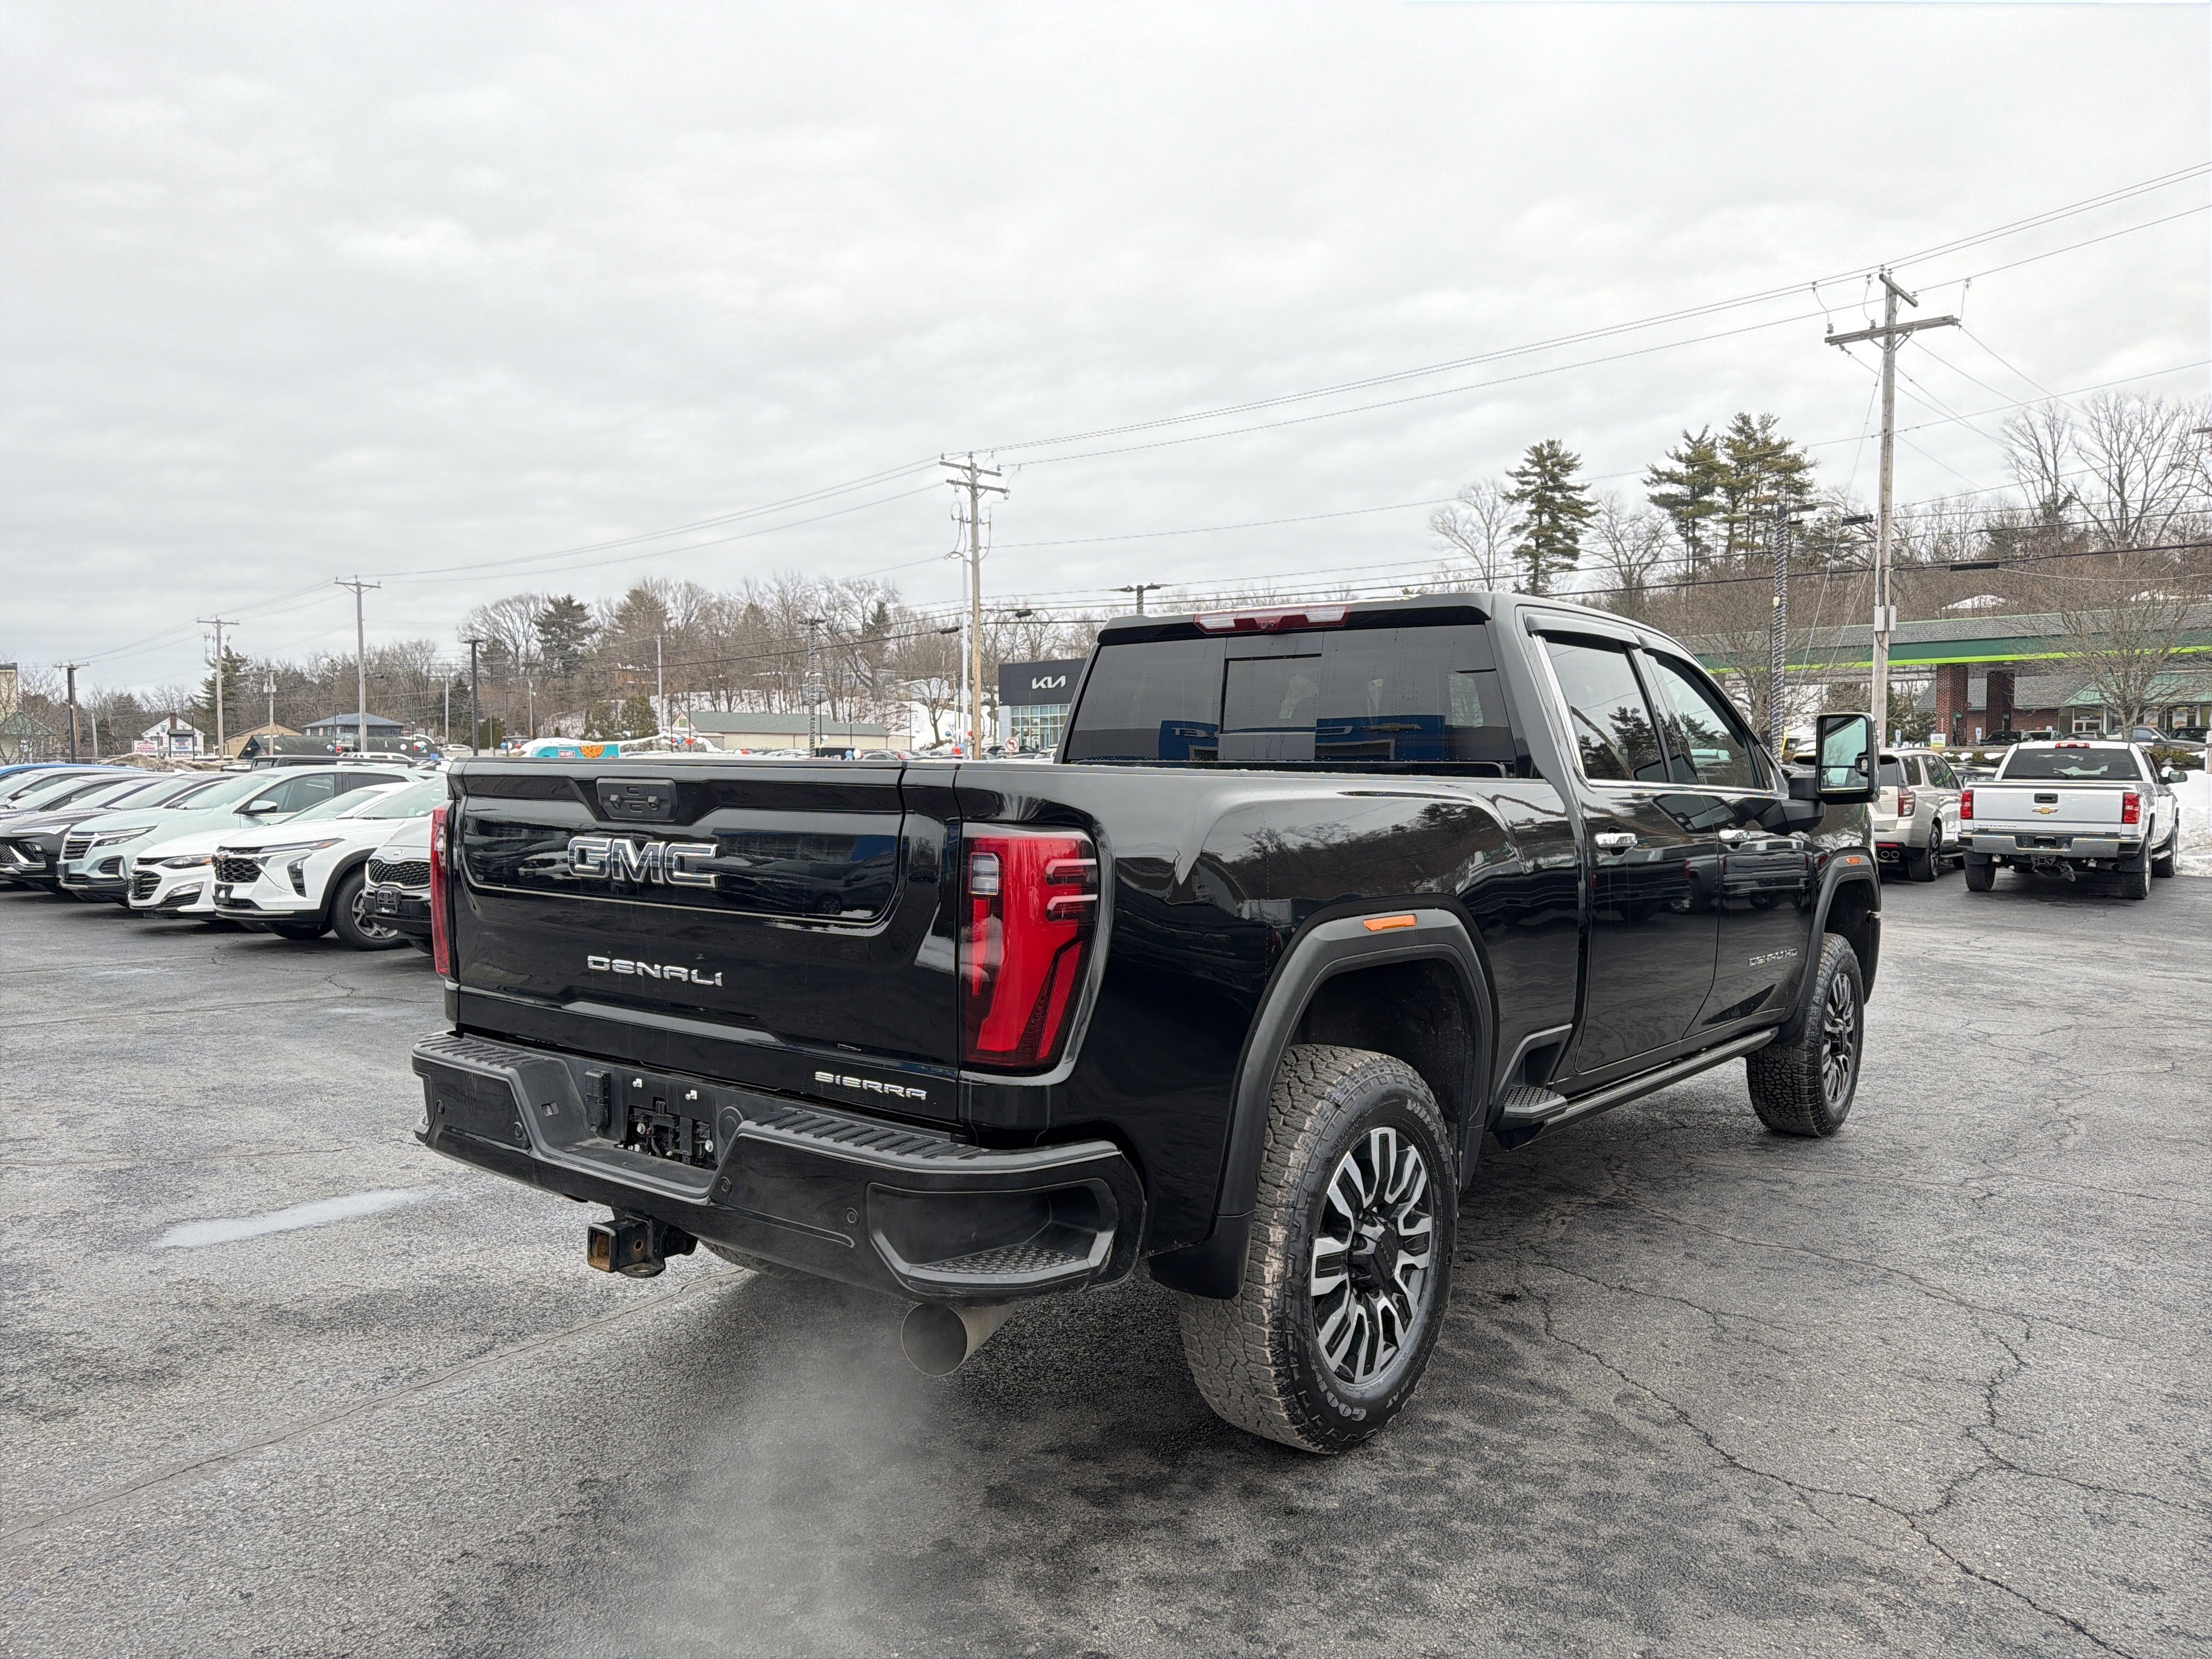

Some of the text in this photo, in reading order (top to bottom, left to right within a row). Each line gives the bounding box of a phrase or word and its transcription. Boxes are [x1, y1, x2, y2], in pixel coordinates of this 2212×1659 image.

[1031, 675, 1066, 690] KIA
[567, 836, 720, 889] GMC
[587, 955, 723, 987] DENALI
[815, 1071, 927, 1101] SIERRA
